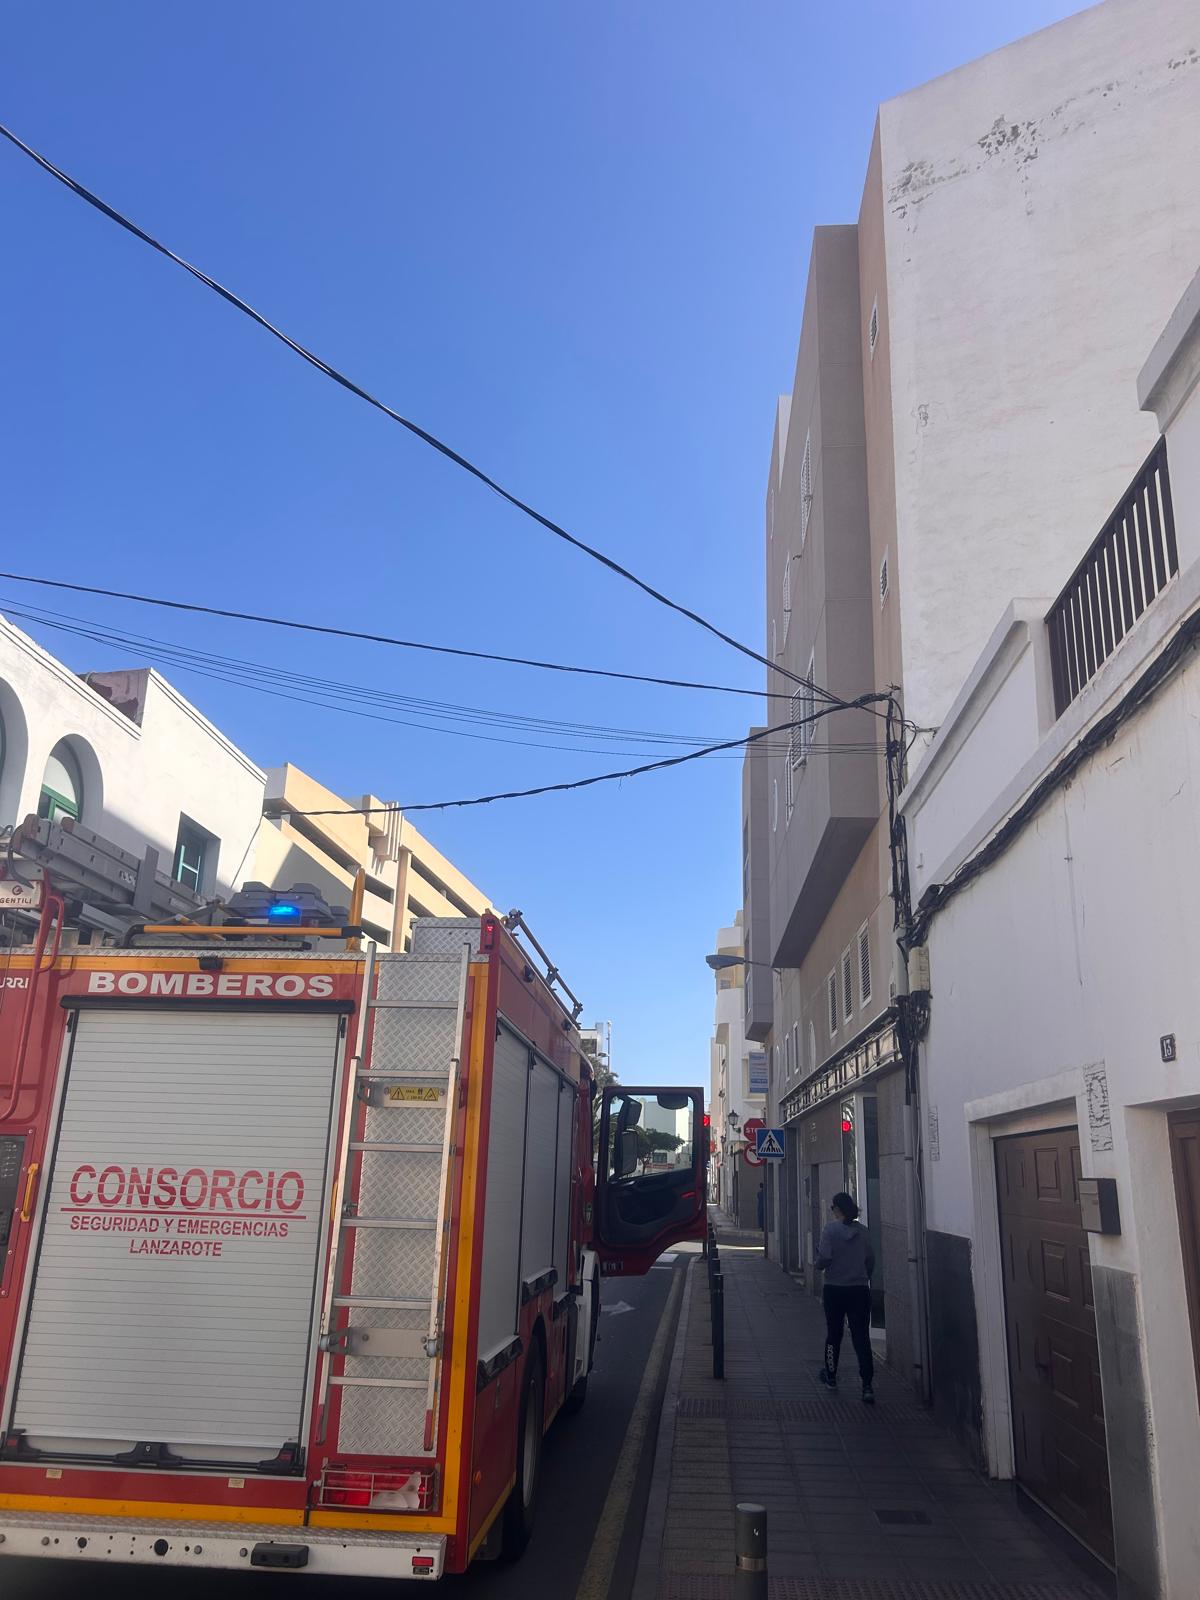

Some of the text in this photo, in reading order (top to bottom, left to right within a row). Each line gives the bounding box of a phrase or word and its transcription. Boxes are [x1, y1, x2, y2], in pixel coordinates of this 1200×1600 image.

[88, 972, 334, 998] BOMBEROS
[70, 1164, 305, 1214] CONSORCIO
[70, 1215, 289, 1238] SEGURIDAD Y EMERGENCIAS
[129, 1239, 223, 1257] LANZAROTE
